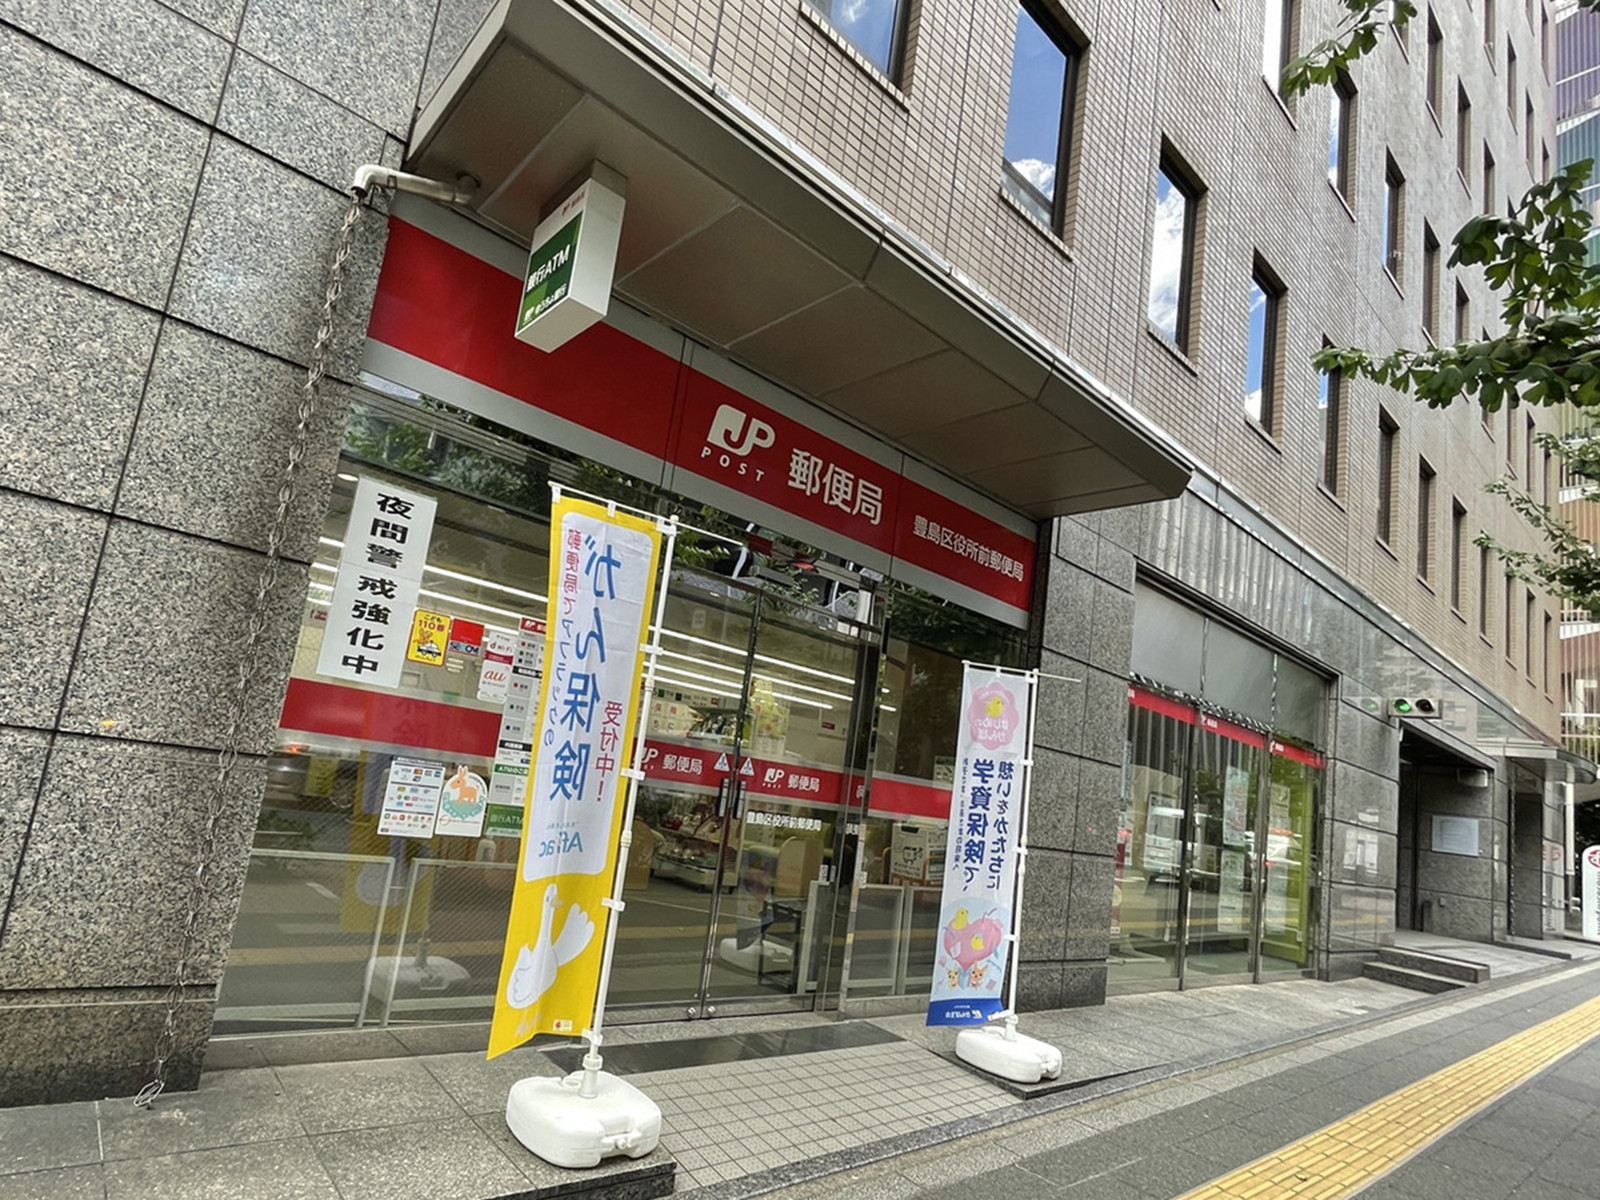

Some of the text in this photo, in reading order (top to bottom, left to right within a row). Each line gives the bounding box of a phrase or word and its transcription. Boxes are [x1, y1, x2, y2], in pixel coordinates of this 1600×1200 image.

[526, 244, 570, 292] 銀行ATM
[706, 404, 775, 456] JP
[701, 446, 765, 482] POST
[788, 448, 883, 526] 郵便局
[912, 514, 1024, 582] 豊島区役所前郵便局
[342, 494, 414, 674] 夜間警戒強化中
[484, 670, 506, 682] au
[662, 754, 702, 775] 郵便局
[788, 774, 820, 792] 郵便局
